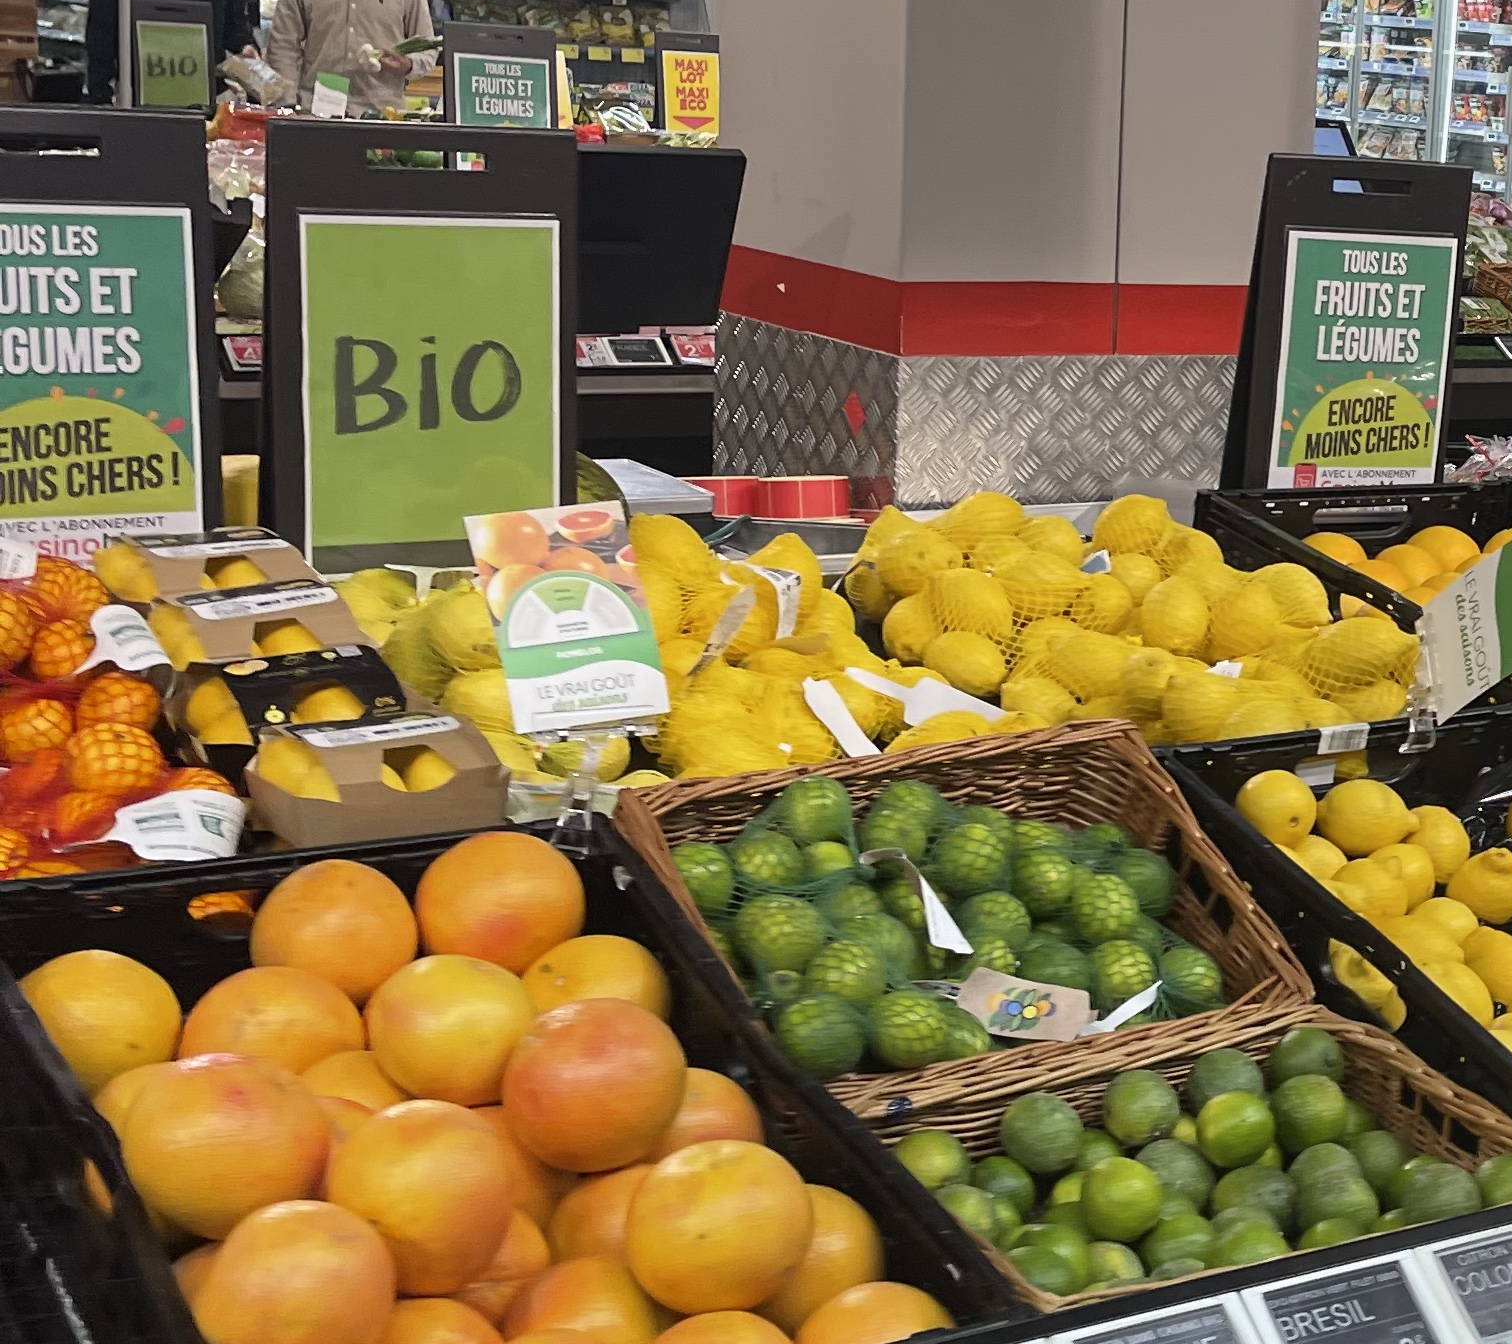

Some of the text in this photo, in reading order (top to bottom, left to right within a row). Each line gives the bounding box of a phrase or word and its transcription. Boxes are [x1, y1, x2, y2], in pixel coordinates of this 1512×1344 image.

[483, 62, 522, 77] TOUS LES
[674, 58, 708, 73] MAXI
[679, 70, 705, 84] LOT
[471, 75, 534, 98] FRUITS ET
[676, 85, 709, 100] MAXI
[475, 96, 534, 118] LÉGUMES
[51, 224, 100, 257] LES
[1342, 249, 1409, 276] TOUS LES
[90, 267, 138, 315] ET
[1314, 279, 1426, 319] FRUITS ET
[1316, 319, 1421, 364] LÉGUMES
[1327, 395, 1397, 427] ENCORE
[1304, 429, 1362, 460] MOINS
[1364, 422, 1422, 455] CHERS
[66, 452, 164, 498] CHERS
[1321, 469, 1345, 479] AVEC
[41, 515, 165, 534] L'ABONNEMENT
[1455, 593, 1475, 688] des saisons
[1464, 569, 1491, 690] LE VRAI GOÛT
[535, 672, 636, 700] LE VRAI GOÛT
[1456, 1243, 1509, 1267] CITRON
[1275, 1299, 1376, 1342] BRESIL
